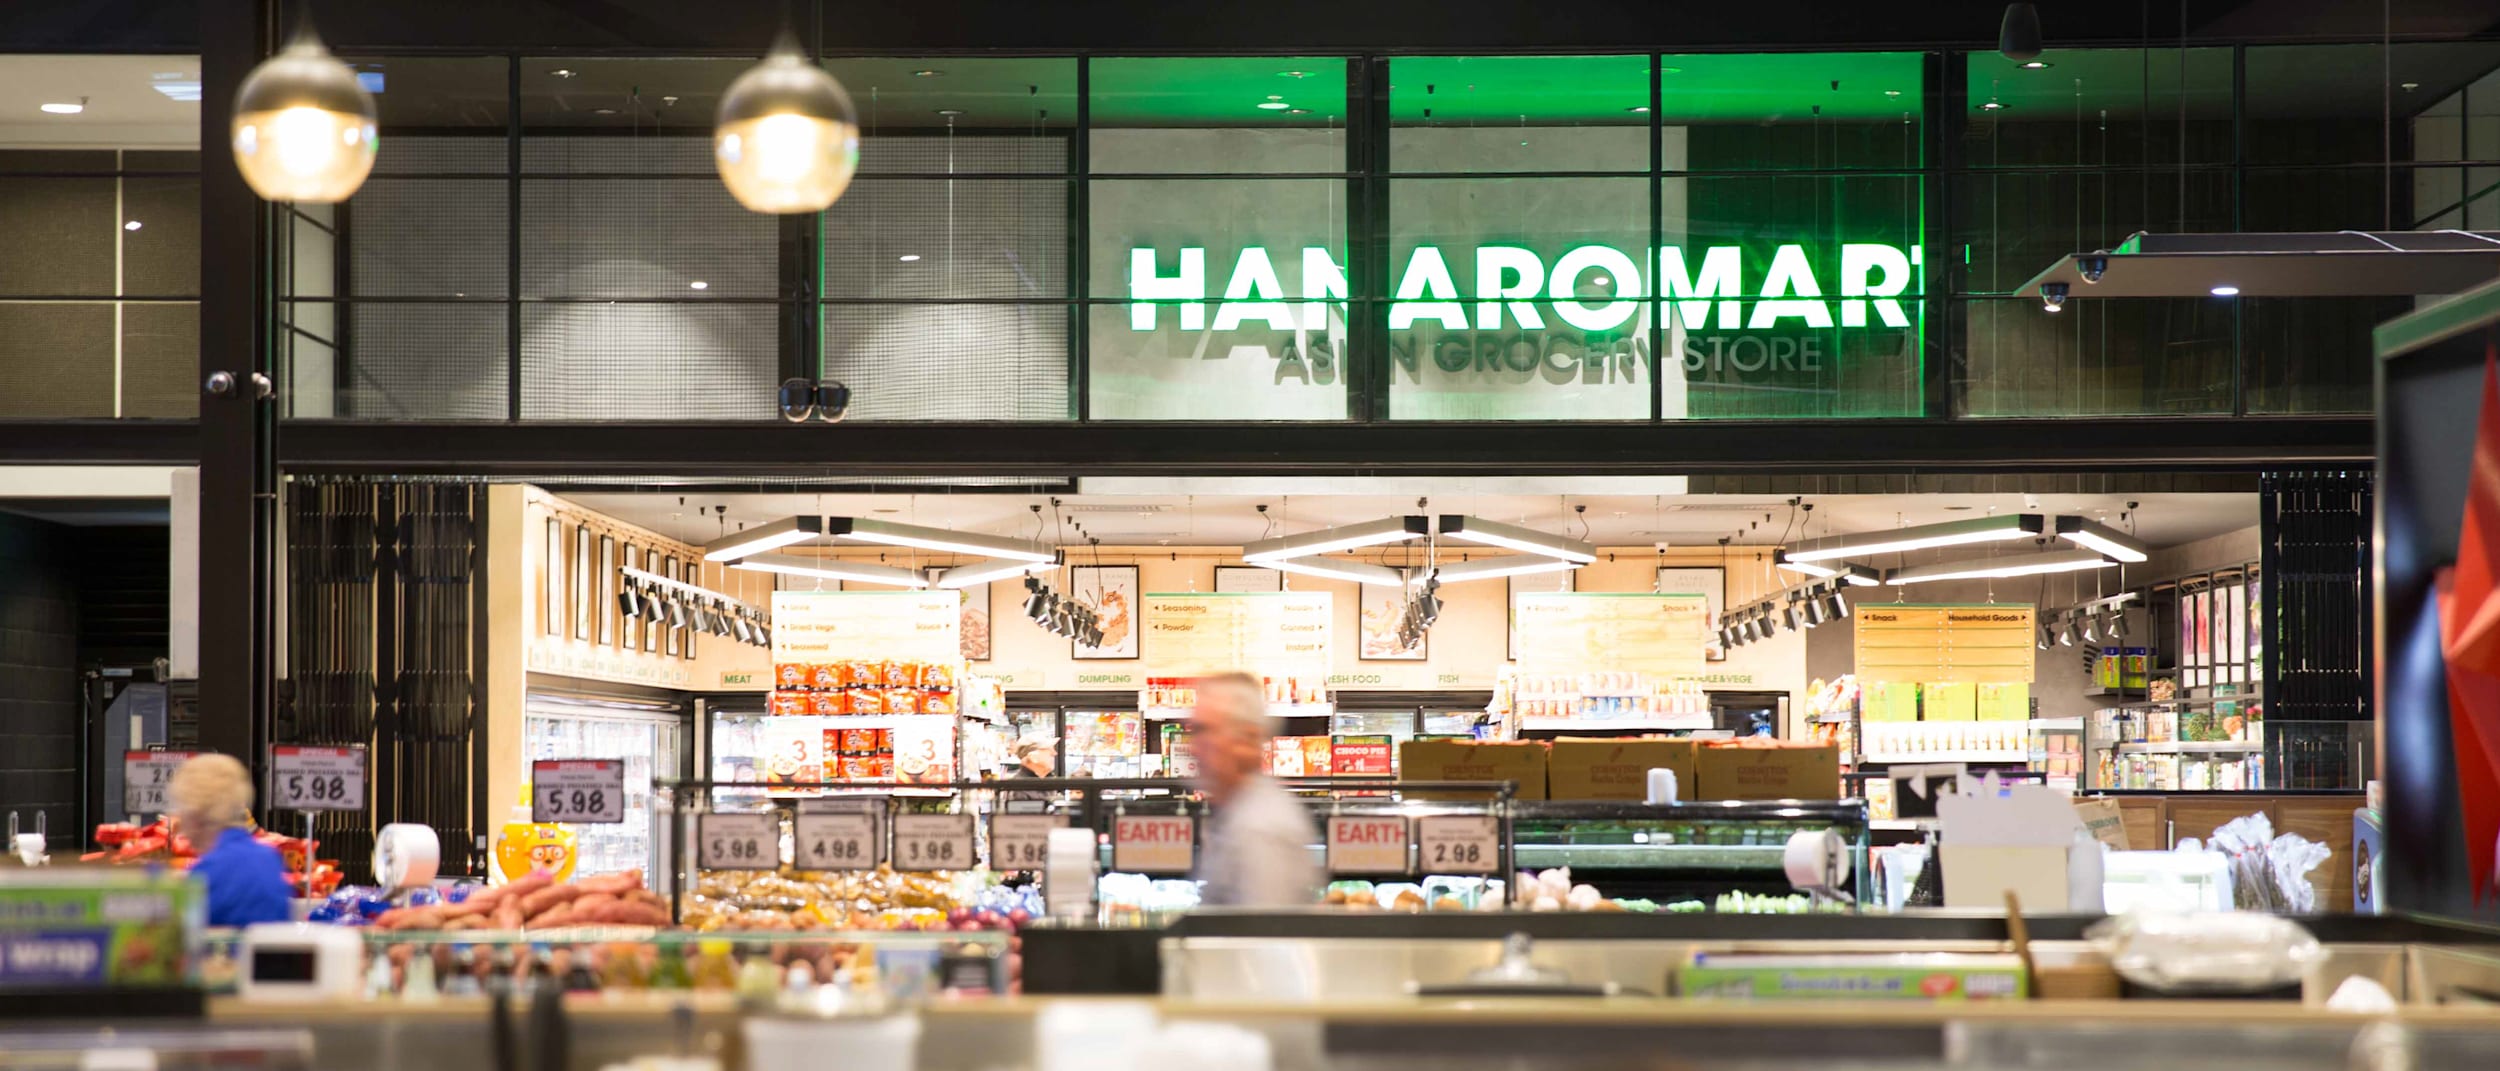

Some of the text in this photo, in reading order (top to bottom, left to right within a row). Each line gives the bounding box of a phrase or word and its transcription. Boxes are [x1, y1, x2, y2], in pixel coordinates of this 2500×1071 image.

[1276, 337, 1416, 373] ASIN
[1682, 336, 1822, 372] STORE
[1161, 604, 1207, 614] Seasoning
[1871, 614, 1898, 622] Snack
[1948, 614, 2019, 622] Household Goods
[1161, 623, 1194, 632] Powder
[723, 674, 753, 684] MEAT
[1078, 674, 1132, 684] DUMPLING
[1328, 674, 1382, 684] ESH FOOD
[1438, 674, 1460, 684] FISH
[1334, 746, 1369, 756] CHOCO
[1370, 746, 1387, 756] PIE
[289, 775, 345, 801] 5.98
[549, 789, 605, 815] 5.98
[1117, 821, 1191, 843] EARTH
[712, 837, 758, 860] 5.98
[813, 838, 860, 860] 4.98
[909, 840, 954, 861] 3.98
[1434, 842, 1480, 864] 2.98
